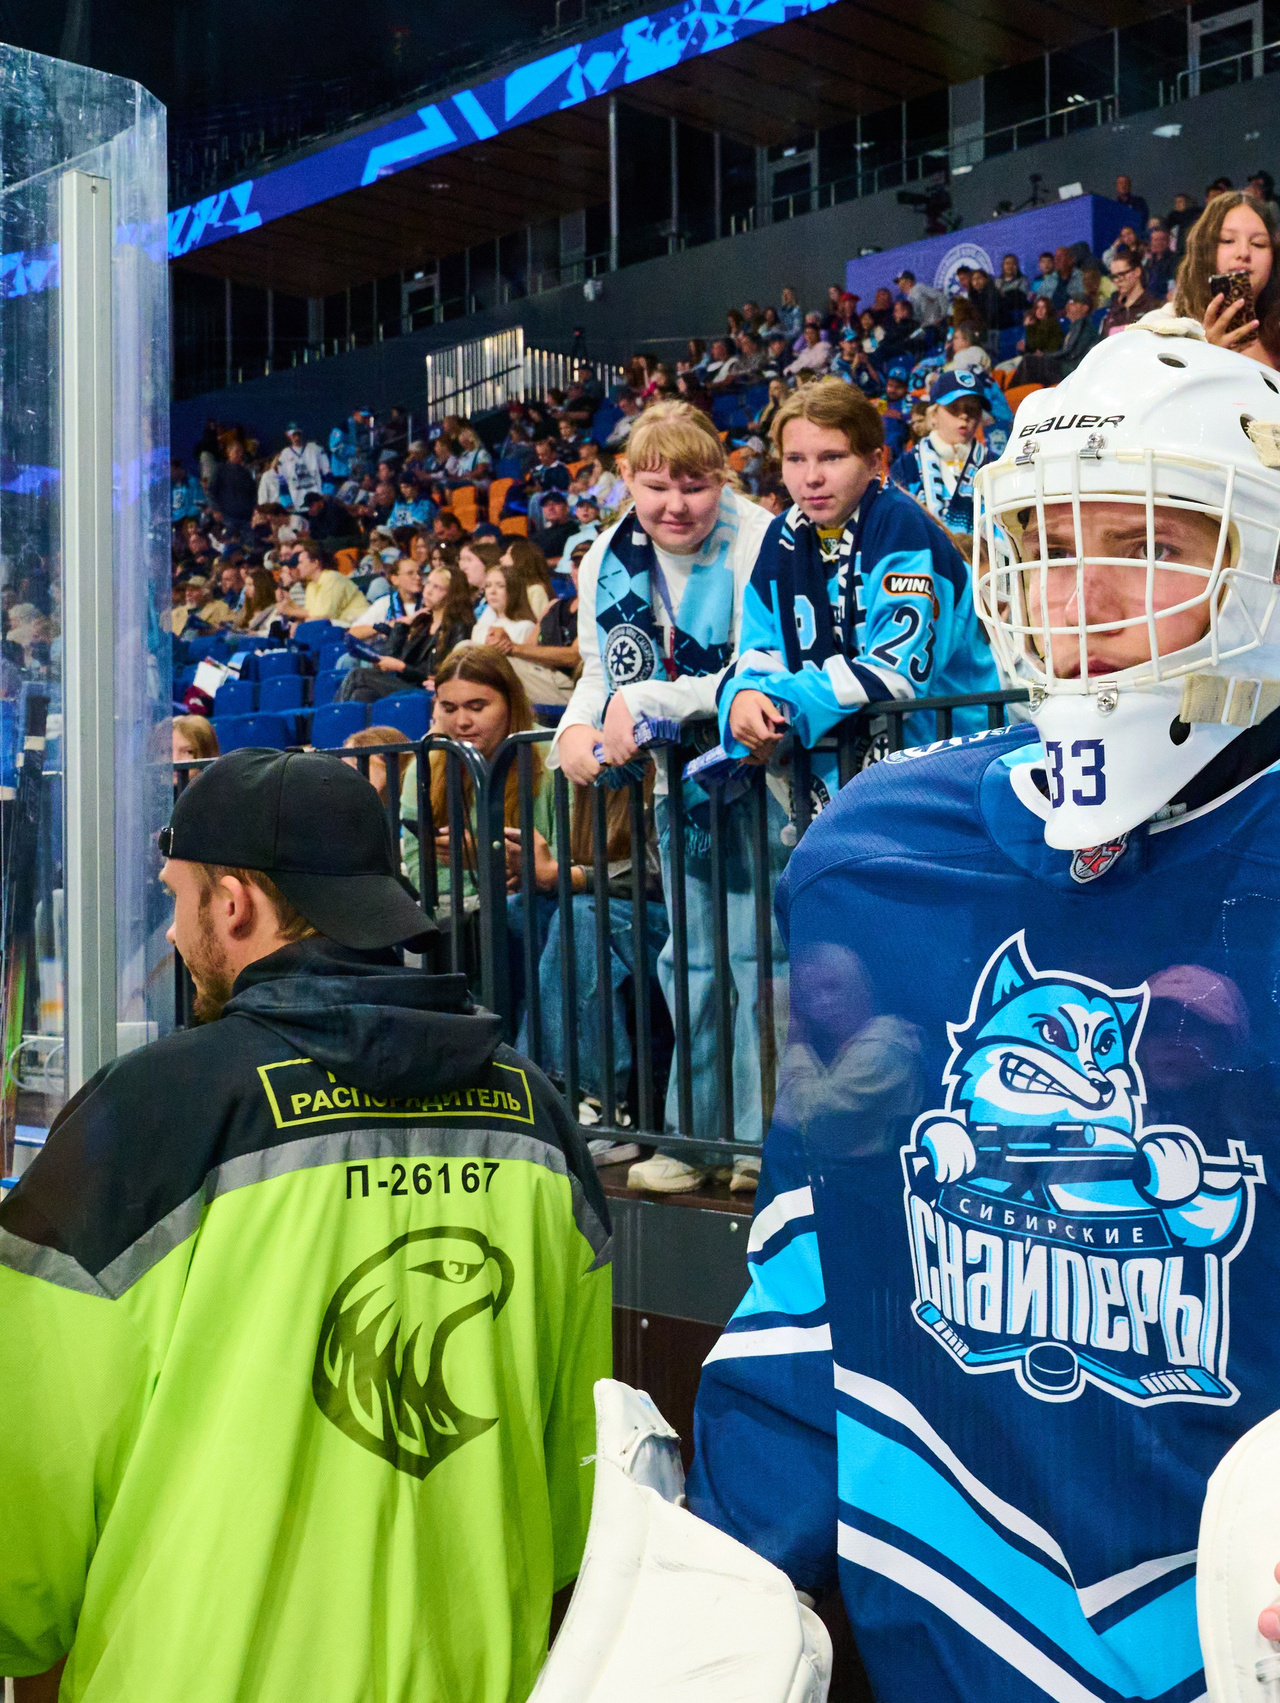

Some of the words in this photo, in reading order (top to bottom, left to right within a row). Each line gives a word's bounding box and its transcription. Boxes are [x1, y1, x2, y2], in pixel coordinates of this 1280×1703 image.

[1019, 414, 1125, 438] BAUER
[869, 606, 937, 683] 23
[1046, 738, 1107, 809] 33
[346, 1162, 500, 1199] П-26167
[959, 1197, 1144, 1244] СИБИРСКИЕ
